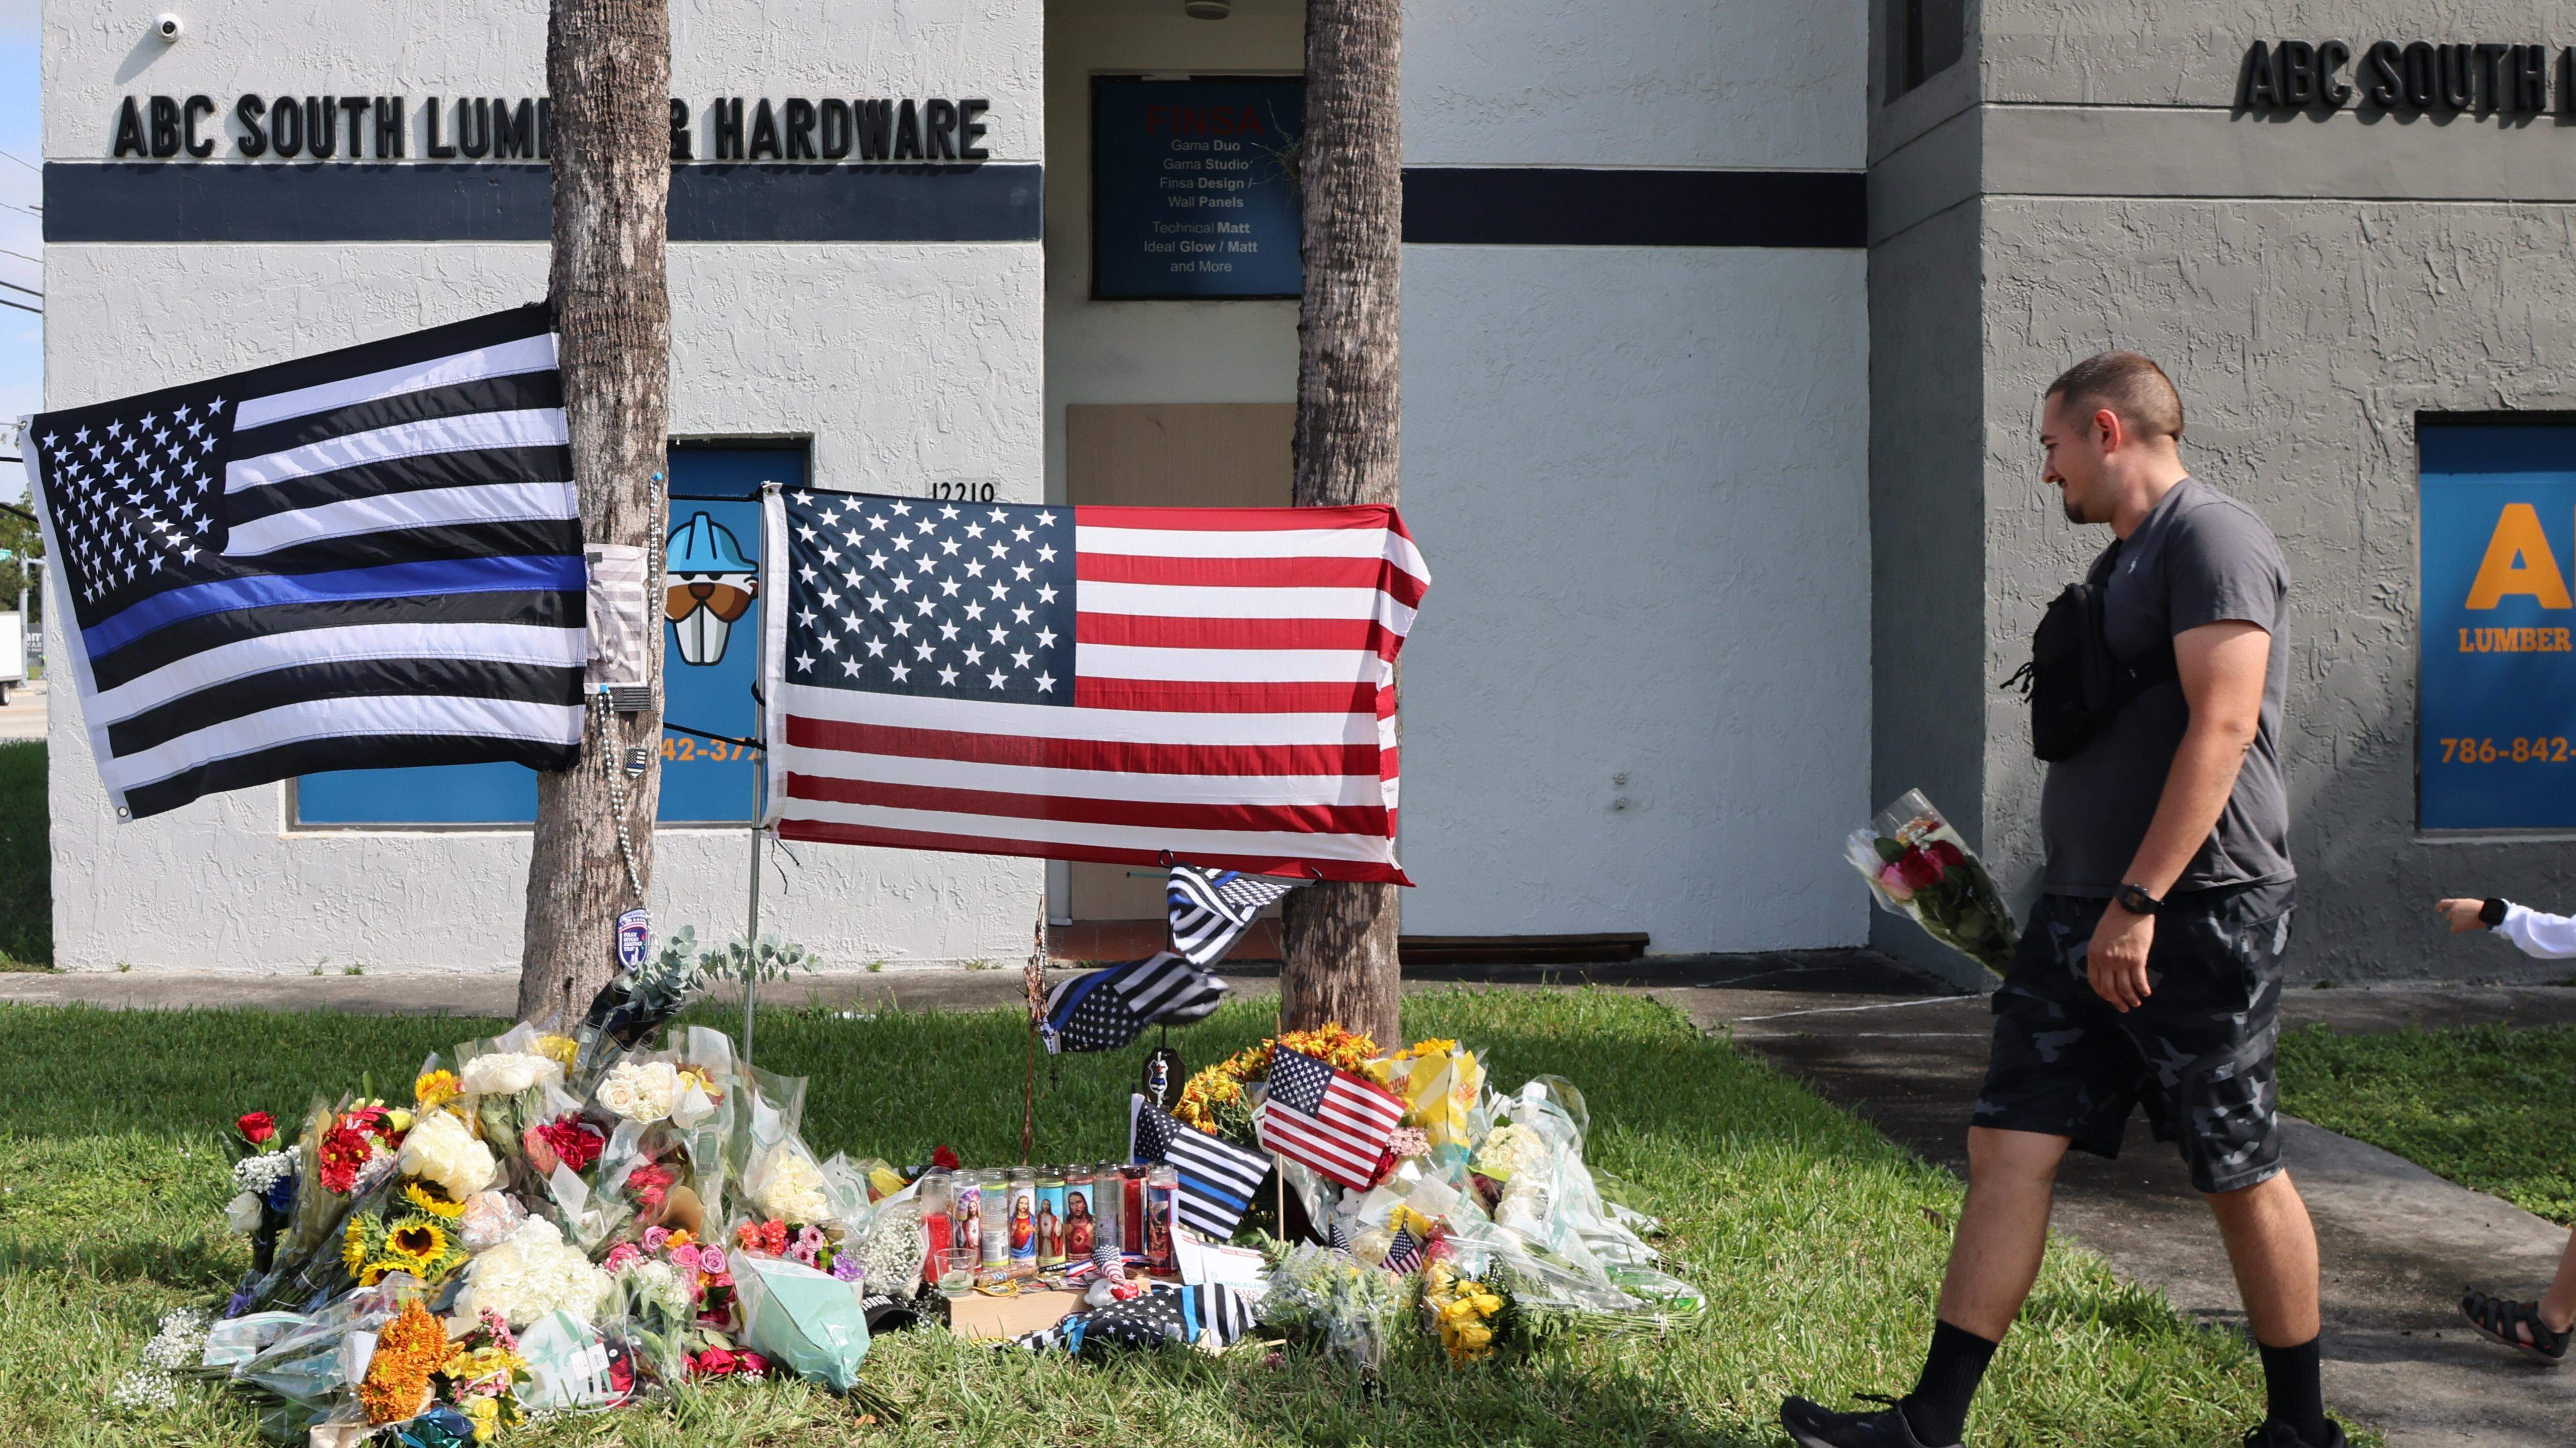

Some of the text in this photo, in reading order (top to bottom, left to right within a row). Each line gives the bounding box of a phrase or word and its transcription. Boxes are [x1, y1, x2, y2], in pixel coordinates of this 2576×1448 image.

[2246, 38, 2351, 108] ABC
[2368, 39, 2547, 111] SOUTH
[114, 95, 215, 157] ABC
[237, 94, 405, 158] SOUTH
[428, 96, 551, 158] LUM
[715, 97, 990, 159] HARDWARE
[1147, 105, 1264, 136] FINSA
[1171, 139, 1240, 151] Gama Duo
[1163, 158, 1249, 170] Gama Studio
[1160, 177, 1194, 188] Finsa
[1198, 177, 1244, 191] Design
[1168, 195, 1244, 208] Wall Panels
[1152, 221, 1251, 233] Technical Matt
[1144, 240, 1258, 253] Ideal Glow / Matt
[1171, 260, 1232, 272] and More
[2465, 503, 2576, 609] A
[2459, 627, 2572, 653] LUMBER
